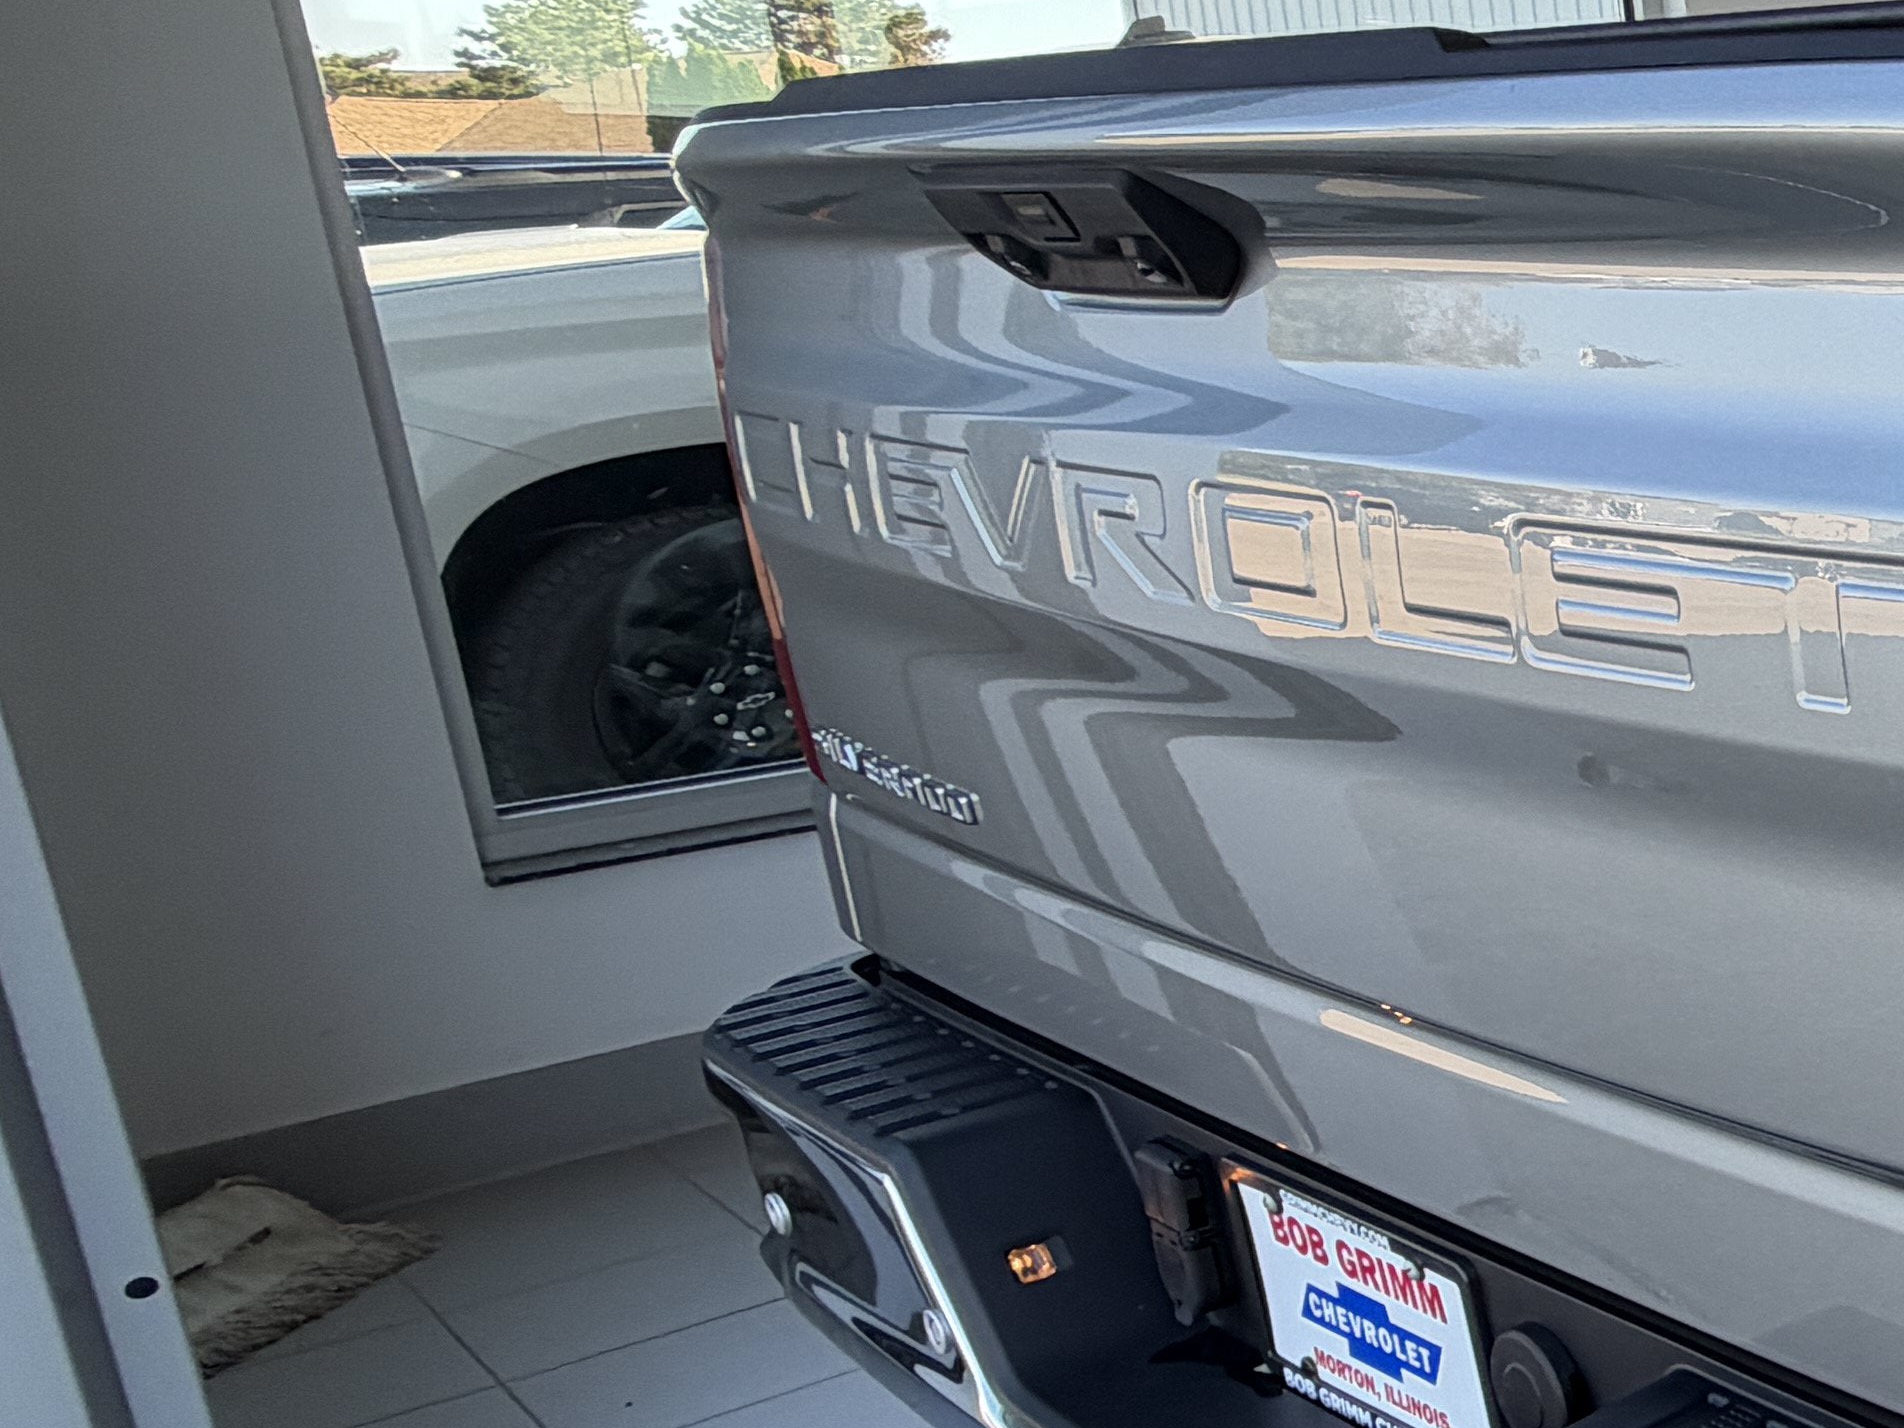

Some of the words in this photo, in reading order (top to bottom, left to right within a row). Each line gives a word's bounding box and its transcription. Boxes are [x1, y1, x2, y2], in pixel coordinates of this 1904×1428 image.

[1269, 1211, 1330, 1267] BOB
[1335, 1239, 1448, 1324] GRIMM
[1308, 1291, 1433, 1374] CHEVROLET
[1283, 1367, 1316, 1401] BOB
